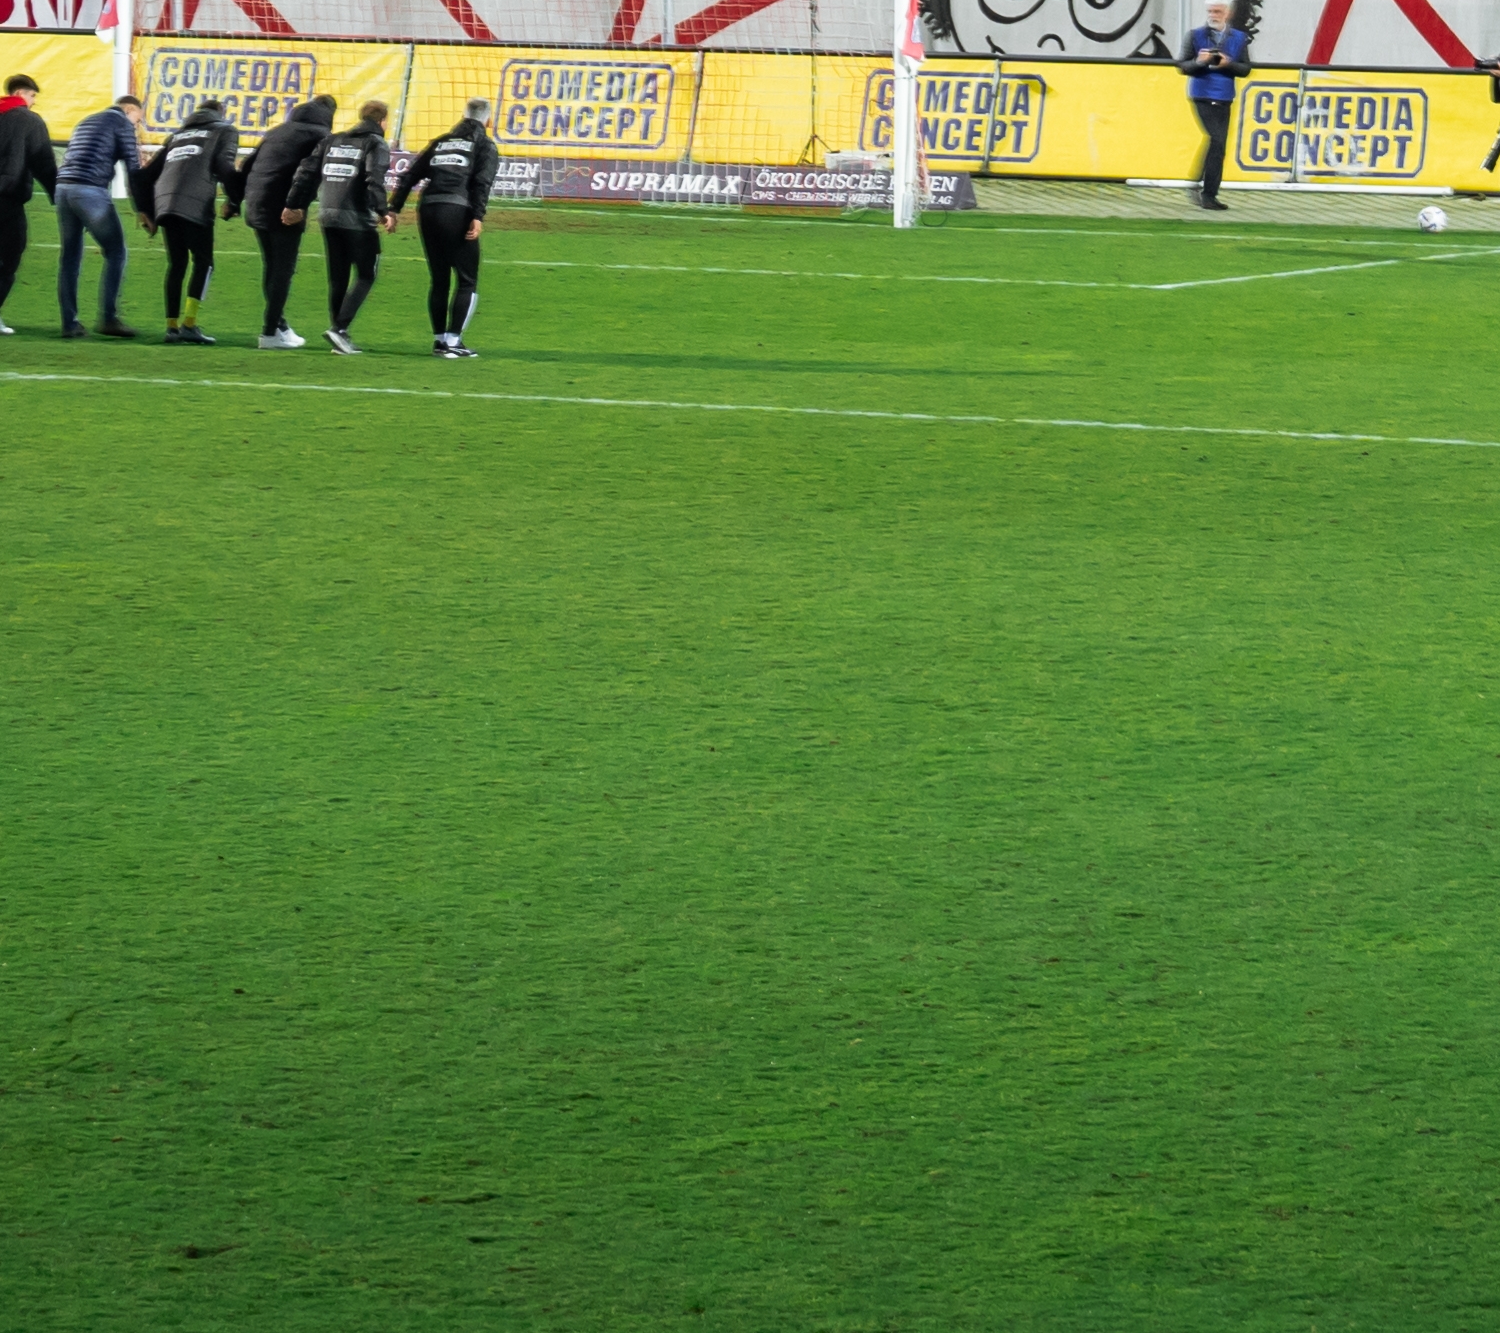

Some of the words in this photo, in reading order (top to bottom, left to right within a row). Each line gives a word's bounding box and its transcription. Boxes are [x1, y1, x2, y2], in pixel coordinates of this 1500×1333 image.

[159, 56, 302, 94] COMEDIA
[511, 66, 660, 106] COMEDIA
[878, 70, 1032, 118] CMEDIA
[505, 98, 657, 142] CONCEPT
[1252, 82, 1414, 131] COMEDIA
[871, 109, 1029, 156] CNCEPT
[1248, 127, 1411, 172] CONCEPT
[590, 170, 742, 196] SUPRAMAX
[755, 169, 885, 191] ÖKOLOGISCHE
